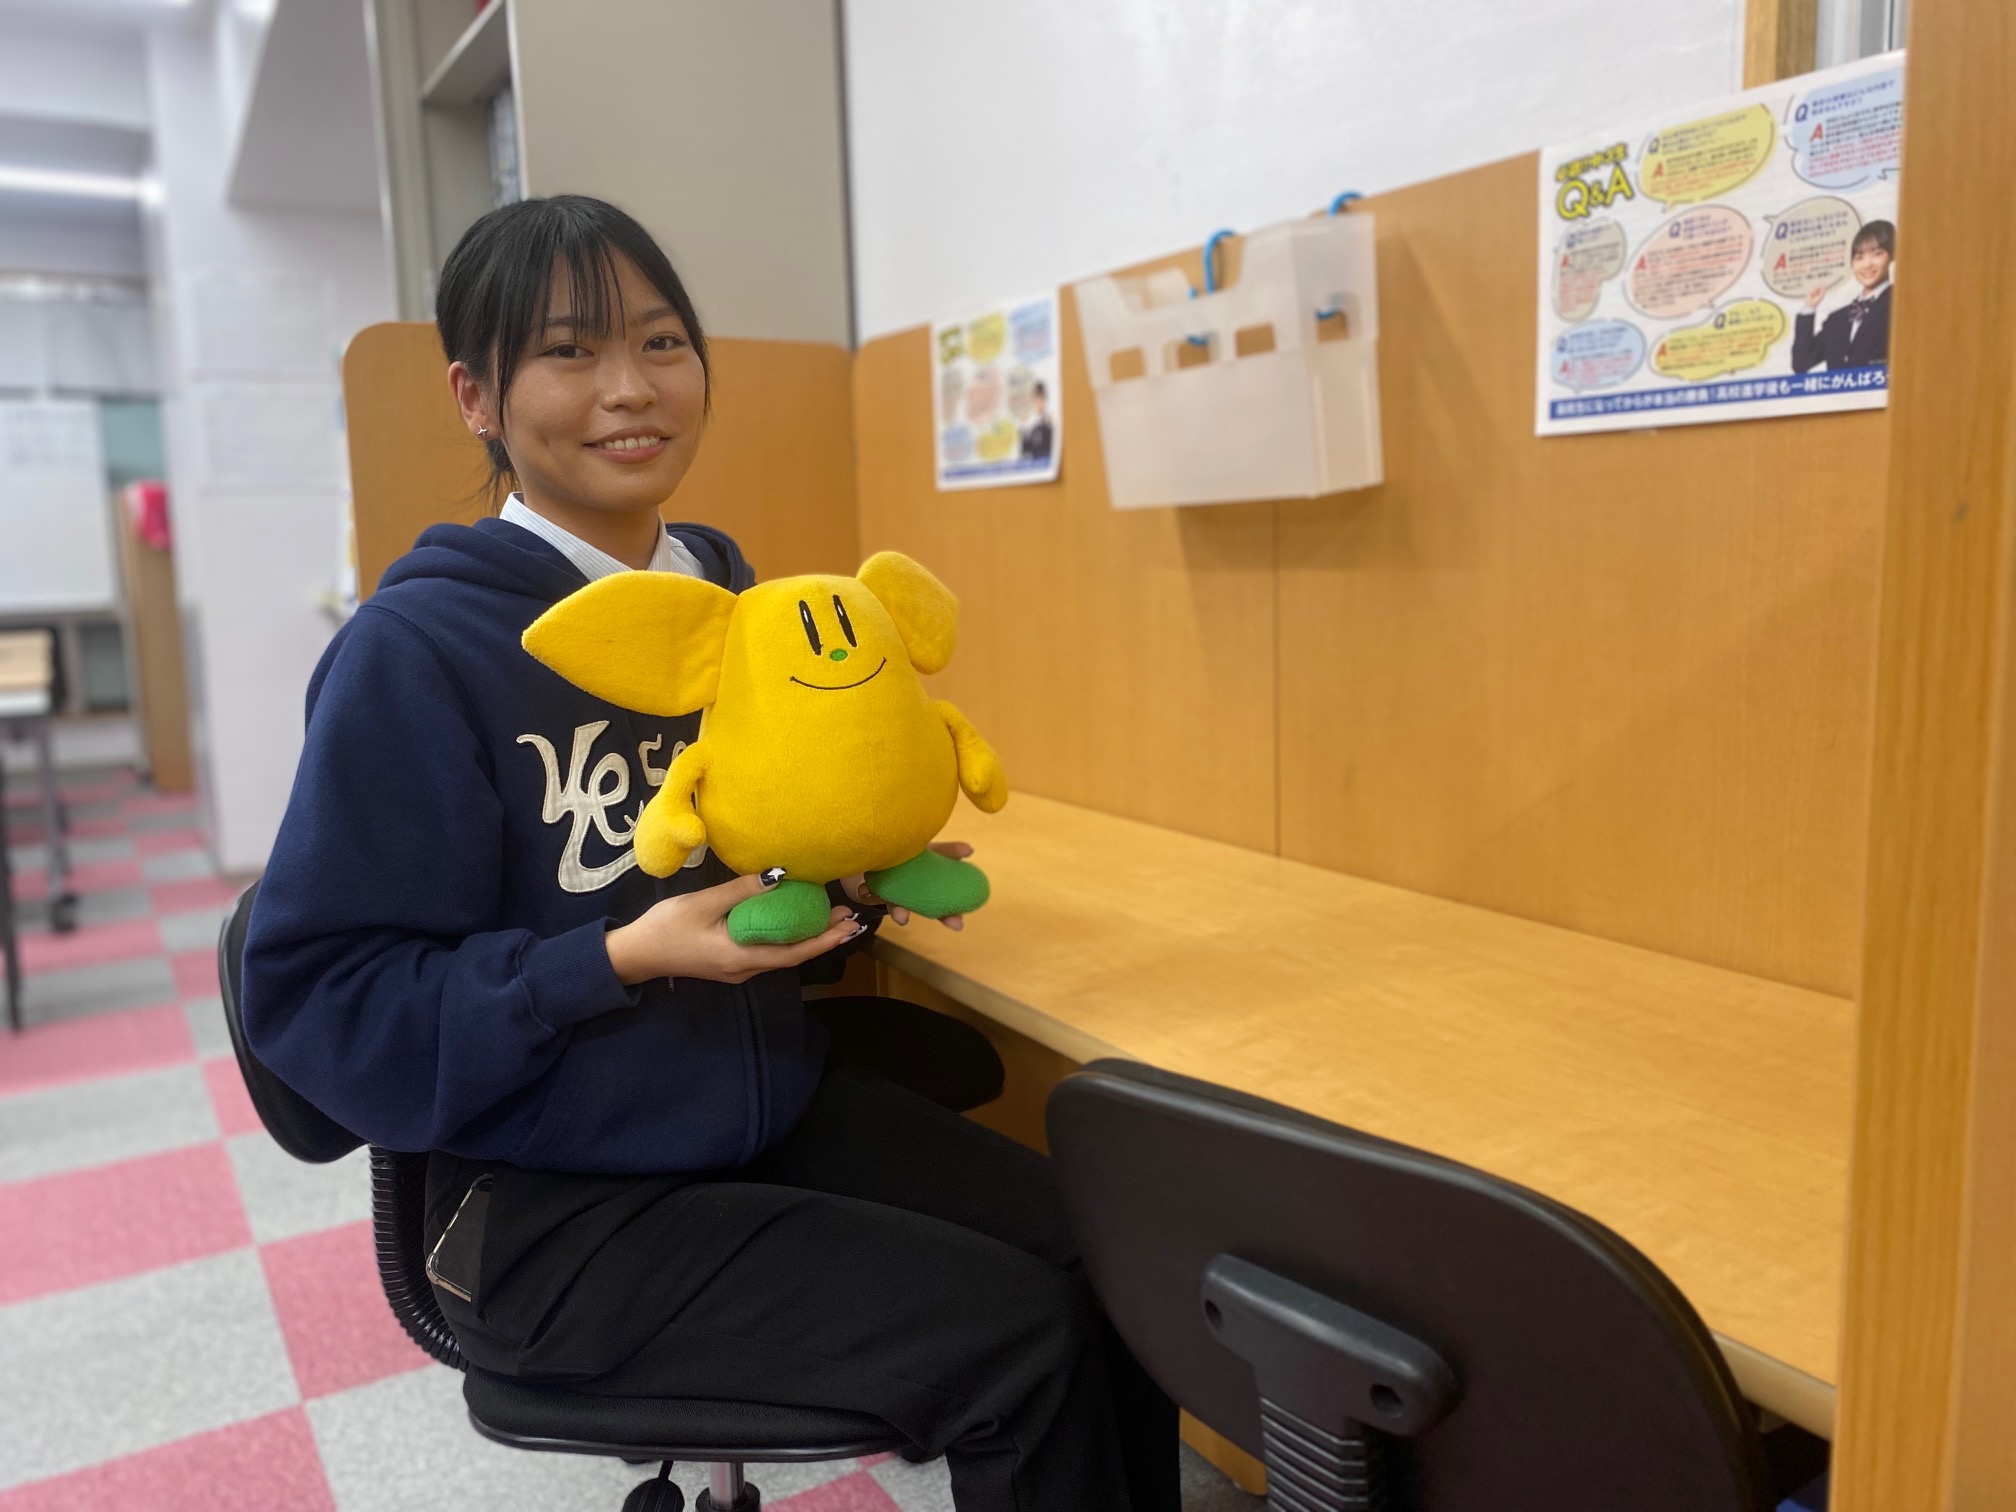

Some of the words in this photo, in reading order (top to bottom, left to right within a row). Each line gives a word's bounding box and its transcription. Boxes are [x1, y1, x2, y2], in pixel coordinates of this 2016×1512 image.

[1795, 103, 1808, 123] Q
[1809, 122, 1823, 142] A
[1556, 162, 1634, 221] Q&A
[1775, 222, 1788, 240] Q
[1774, 253, 1787, 272] A
